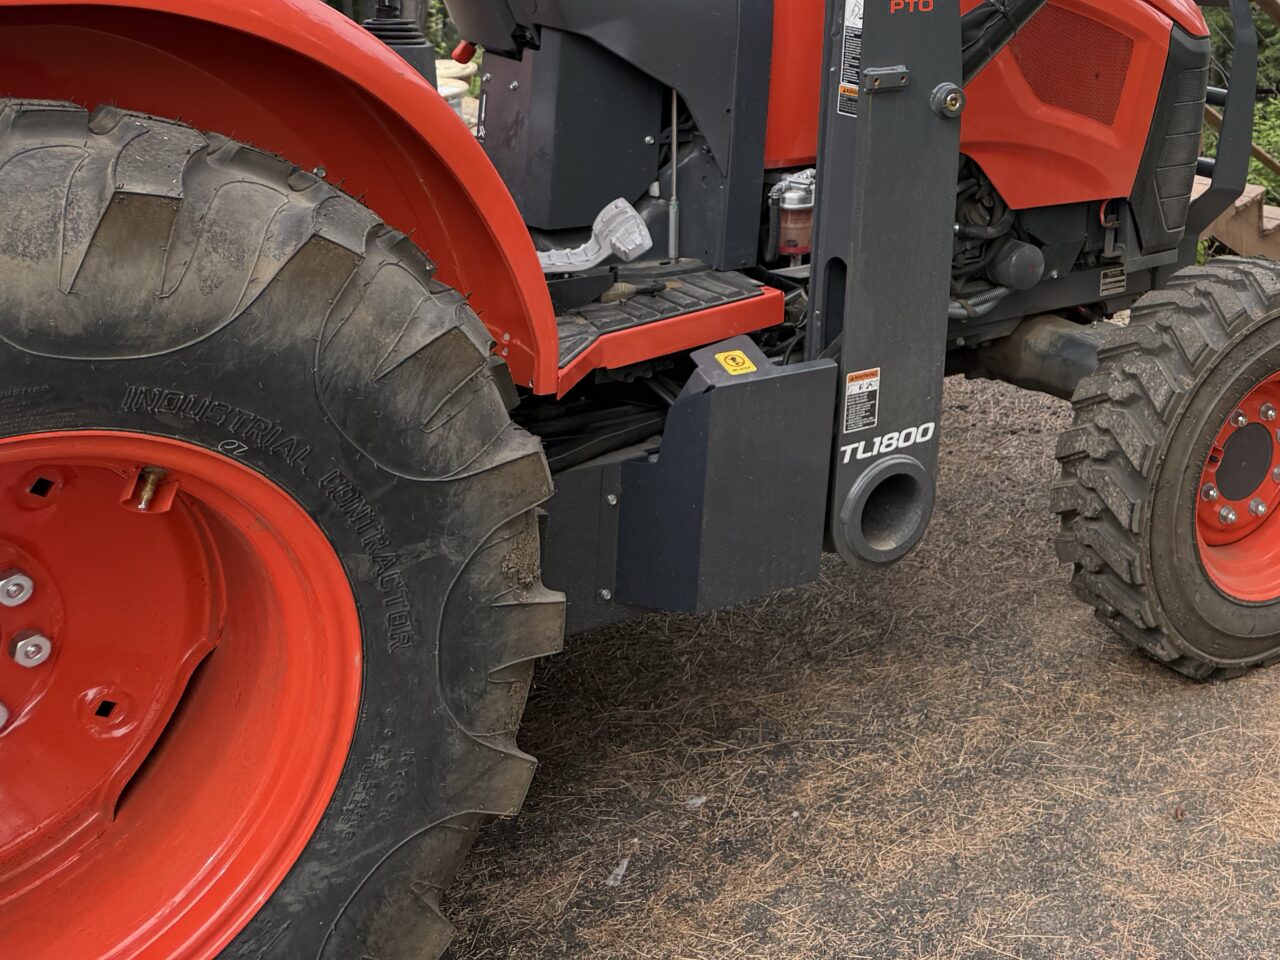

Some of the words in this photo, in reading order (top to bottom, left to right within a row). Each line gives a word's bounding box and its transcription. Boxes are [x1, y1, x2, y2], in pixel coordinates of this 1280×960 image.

[840, 422, 935, 463] TL1800
[121, 386, 312, 475] INDUSTRIAL
[318, 469, 412, 654] CONTRACTOR
